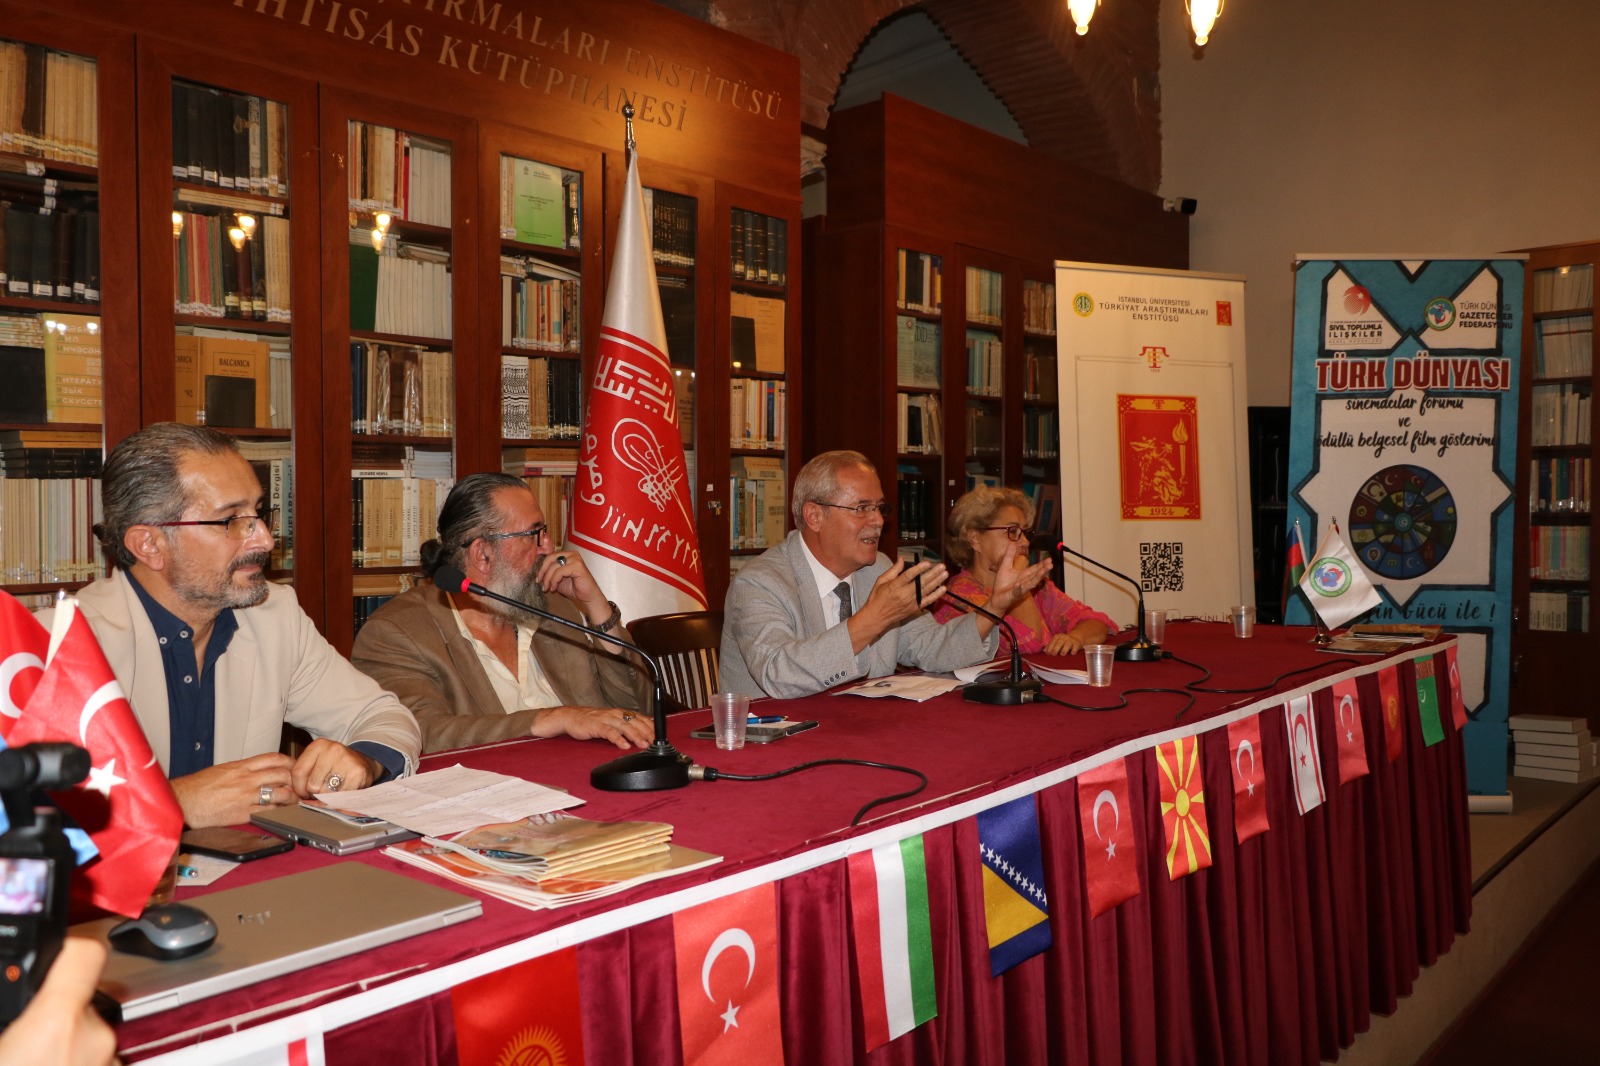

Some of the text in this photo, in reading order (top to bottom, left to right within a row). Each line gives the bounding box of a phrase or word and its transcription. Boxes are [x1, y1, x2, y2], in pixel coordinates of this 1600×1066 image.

[438, 35, 688, 132] KÜTÜPHANESİ
[625, 46, 783, 120] ENSTİTÜSÜ
[1099, 303, 1209, 316] TÜRKİYAT ARAŞTIRMALARI
[1459, 301, 1512, 311] TÜRK DÜNASI
[1132, 313, 1179, 322] ENSTİTÜSÜ
[1459, 312, 1513, 321] GAZETECER
[1347, 323, 1383, 331] TOPLUMLA
[218, 358, 250, 368] BALCANICA
[1315, 350, 1512, 392] TÜRK DÜNYASI
[1345, 394, 1464, 416] sinemacılar forumu
[1398, 416, 1411, 428] ve
[1358, 431, 1408, 458] belgesel
[1411, 430, 1437, 453] film
[273, 465, 281, 499] Dergisi
[1149, 506, 1175, 516] 1924
[1456, 599, 1481, 620] ile
